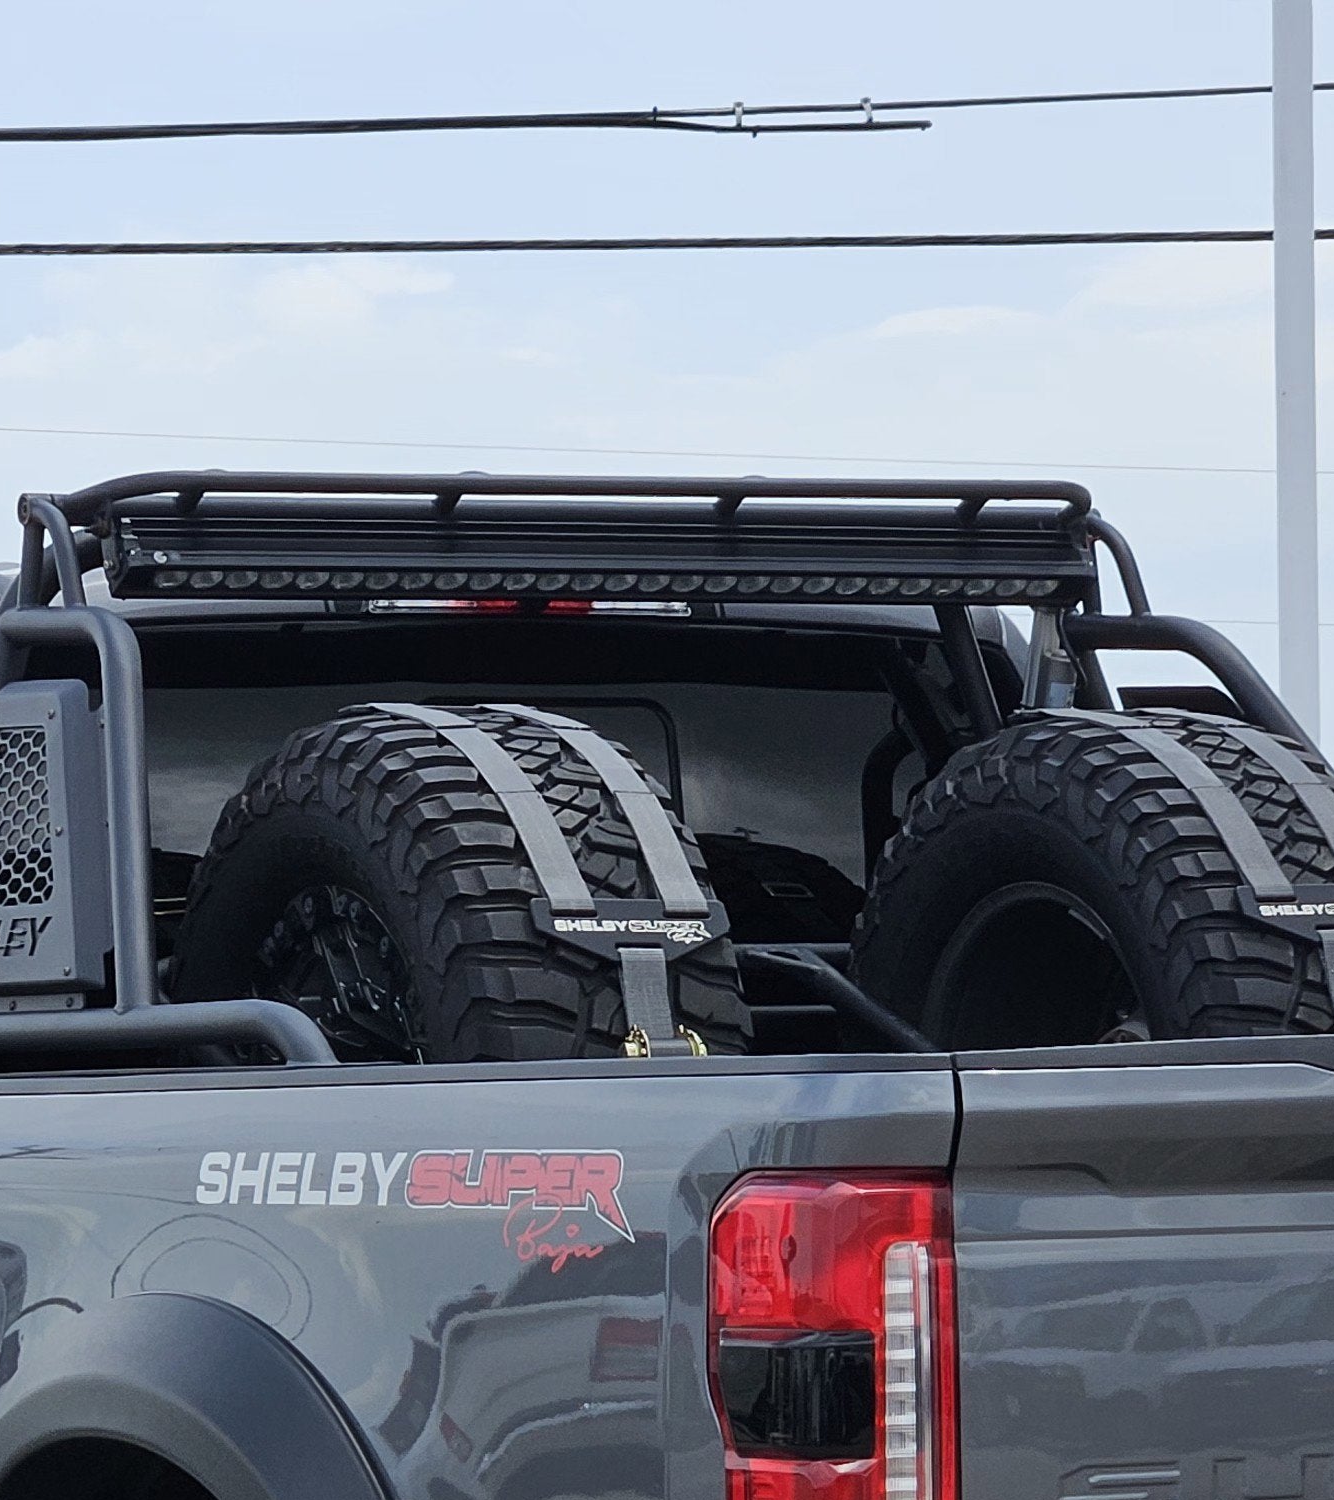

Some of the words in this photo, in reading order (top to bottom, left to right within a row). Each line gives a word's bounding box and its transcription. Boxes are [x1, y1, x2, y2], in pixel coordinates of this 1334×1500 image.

[196, 1151, 407, 1206] SHELBY
[405, 1149, 635, 1243] SUPER
[503, 1193, 604, 1273] Baja
